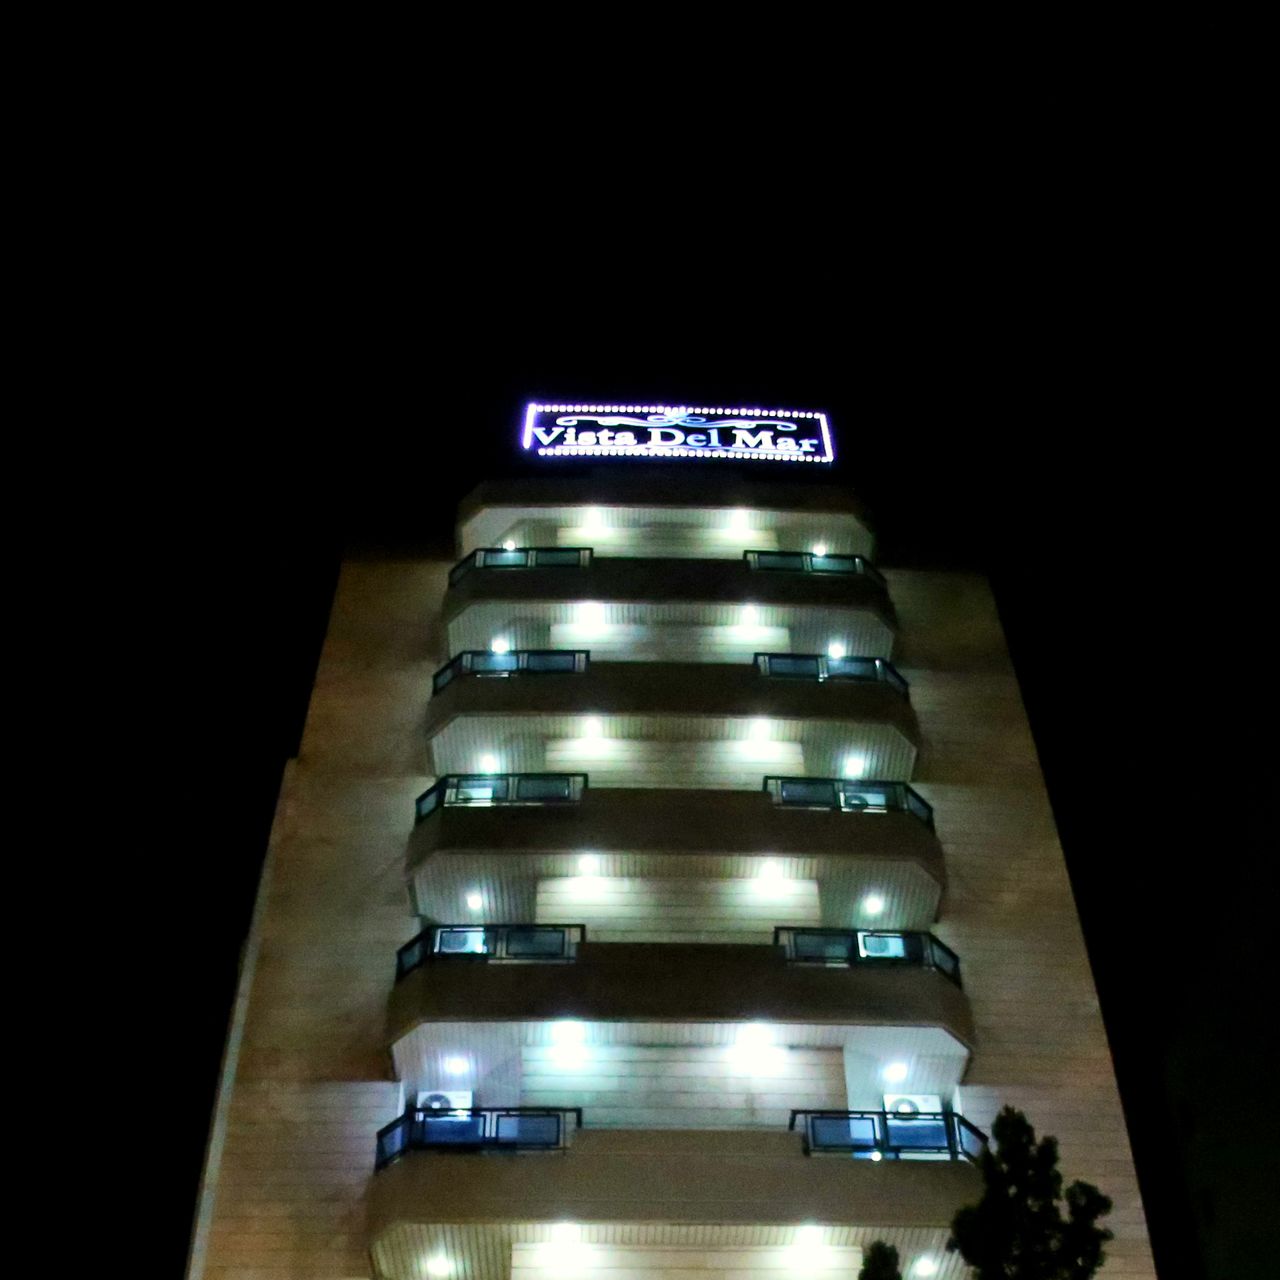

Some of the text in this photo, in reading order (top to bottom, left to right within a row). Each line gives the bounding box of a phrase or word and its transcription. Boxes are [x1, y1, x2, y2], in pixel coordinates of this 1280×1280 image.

[532, 426, 819, 453] Vista Del Mar
